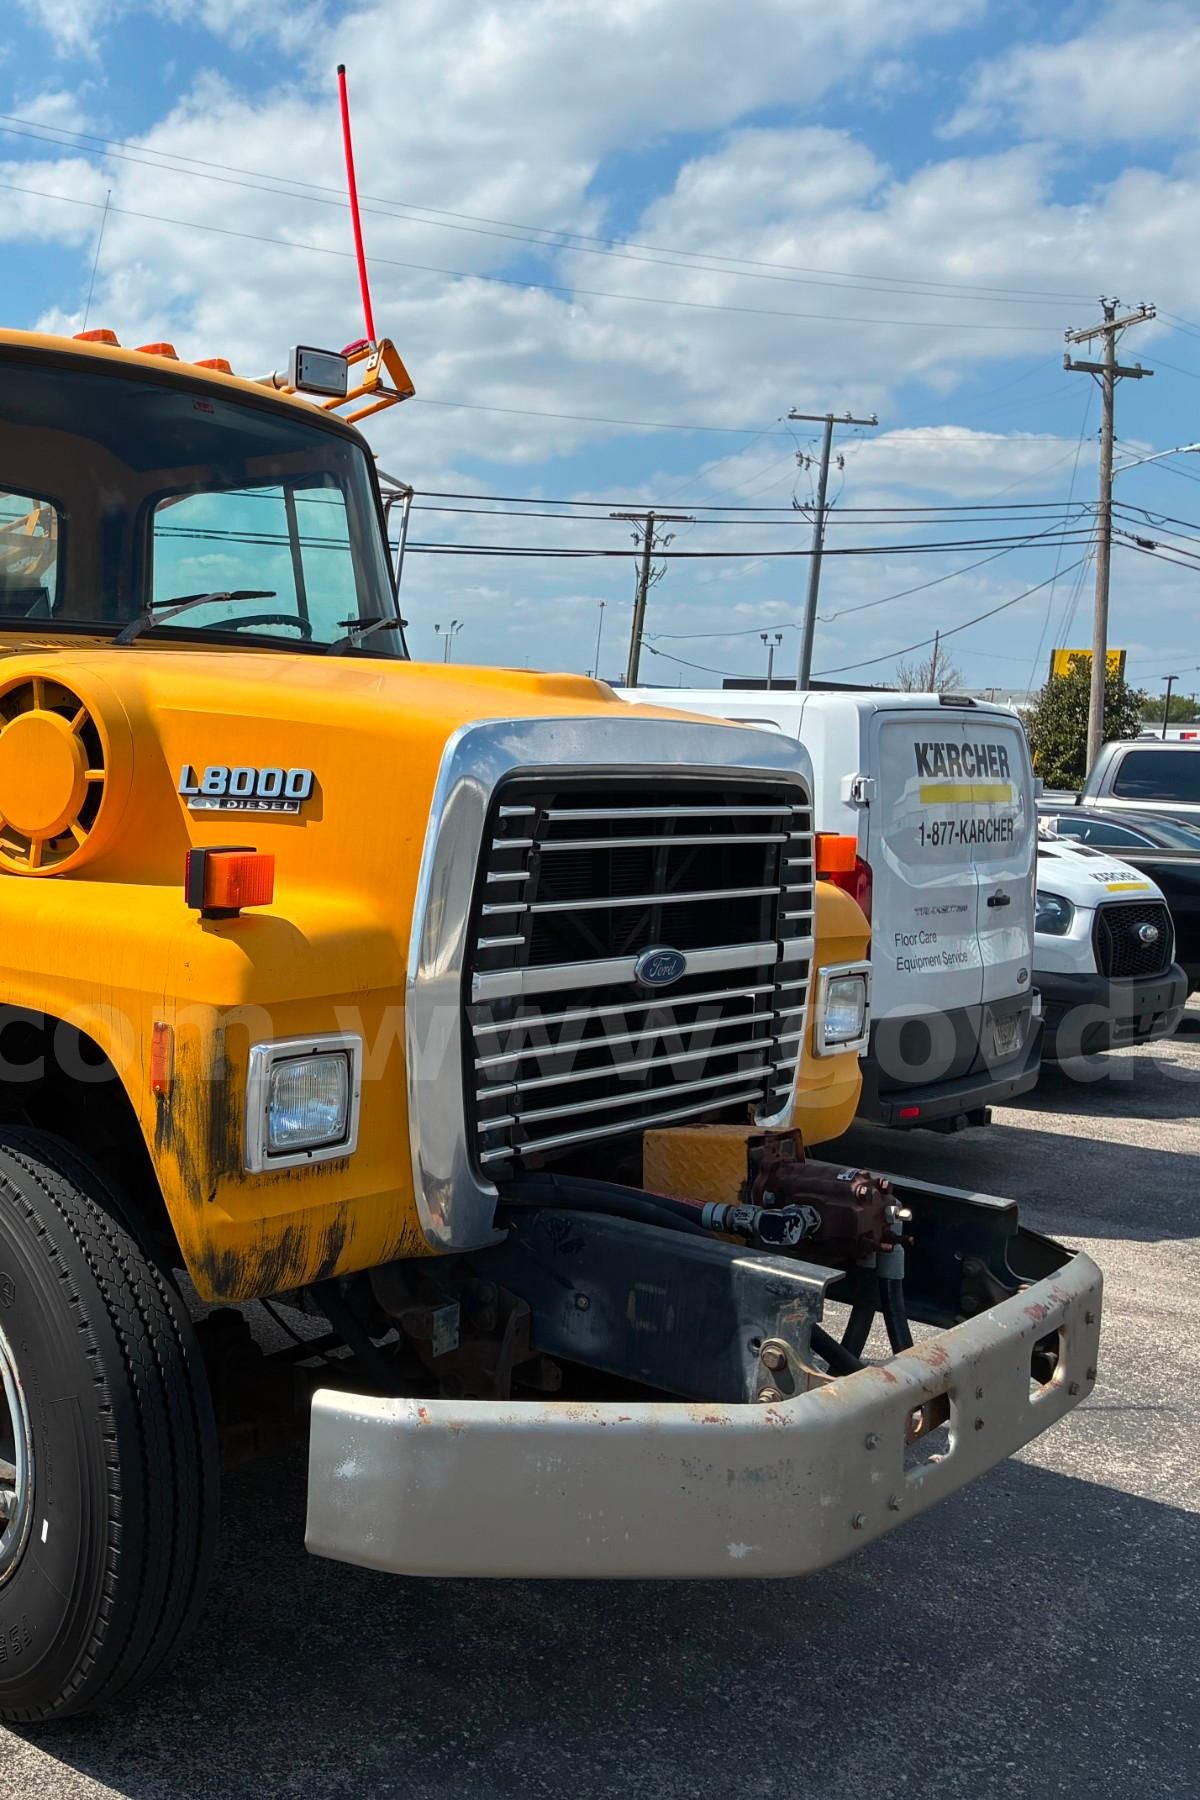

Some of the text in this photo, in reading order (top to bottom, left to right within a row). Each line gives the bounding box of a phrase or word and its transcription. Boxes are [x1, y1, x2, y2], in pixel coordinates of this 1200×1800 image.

[914, 742, 1010, 778] KÄRCHER
[179, 765, 314, 799] L8000
[226, 800, 294, 811] DIESEL
[918, 818, 1014, 846] 1-877-KARCHER
[894, 930, 937, 947] Floor Care
[649, 956, 678, 977] Ford
[896, 951, 968, 973] Equipment Service
